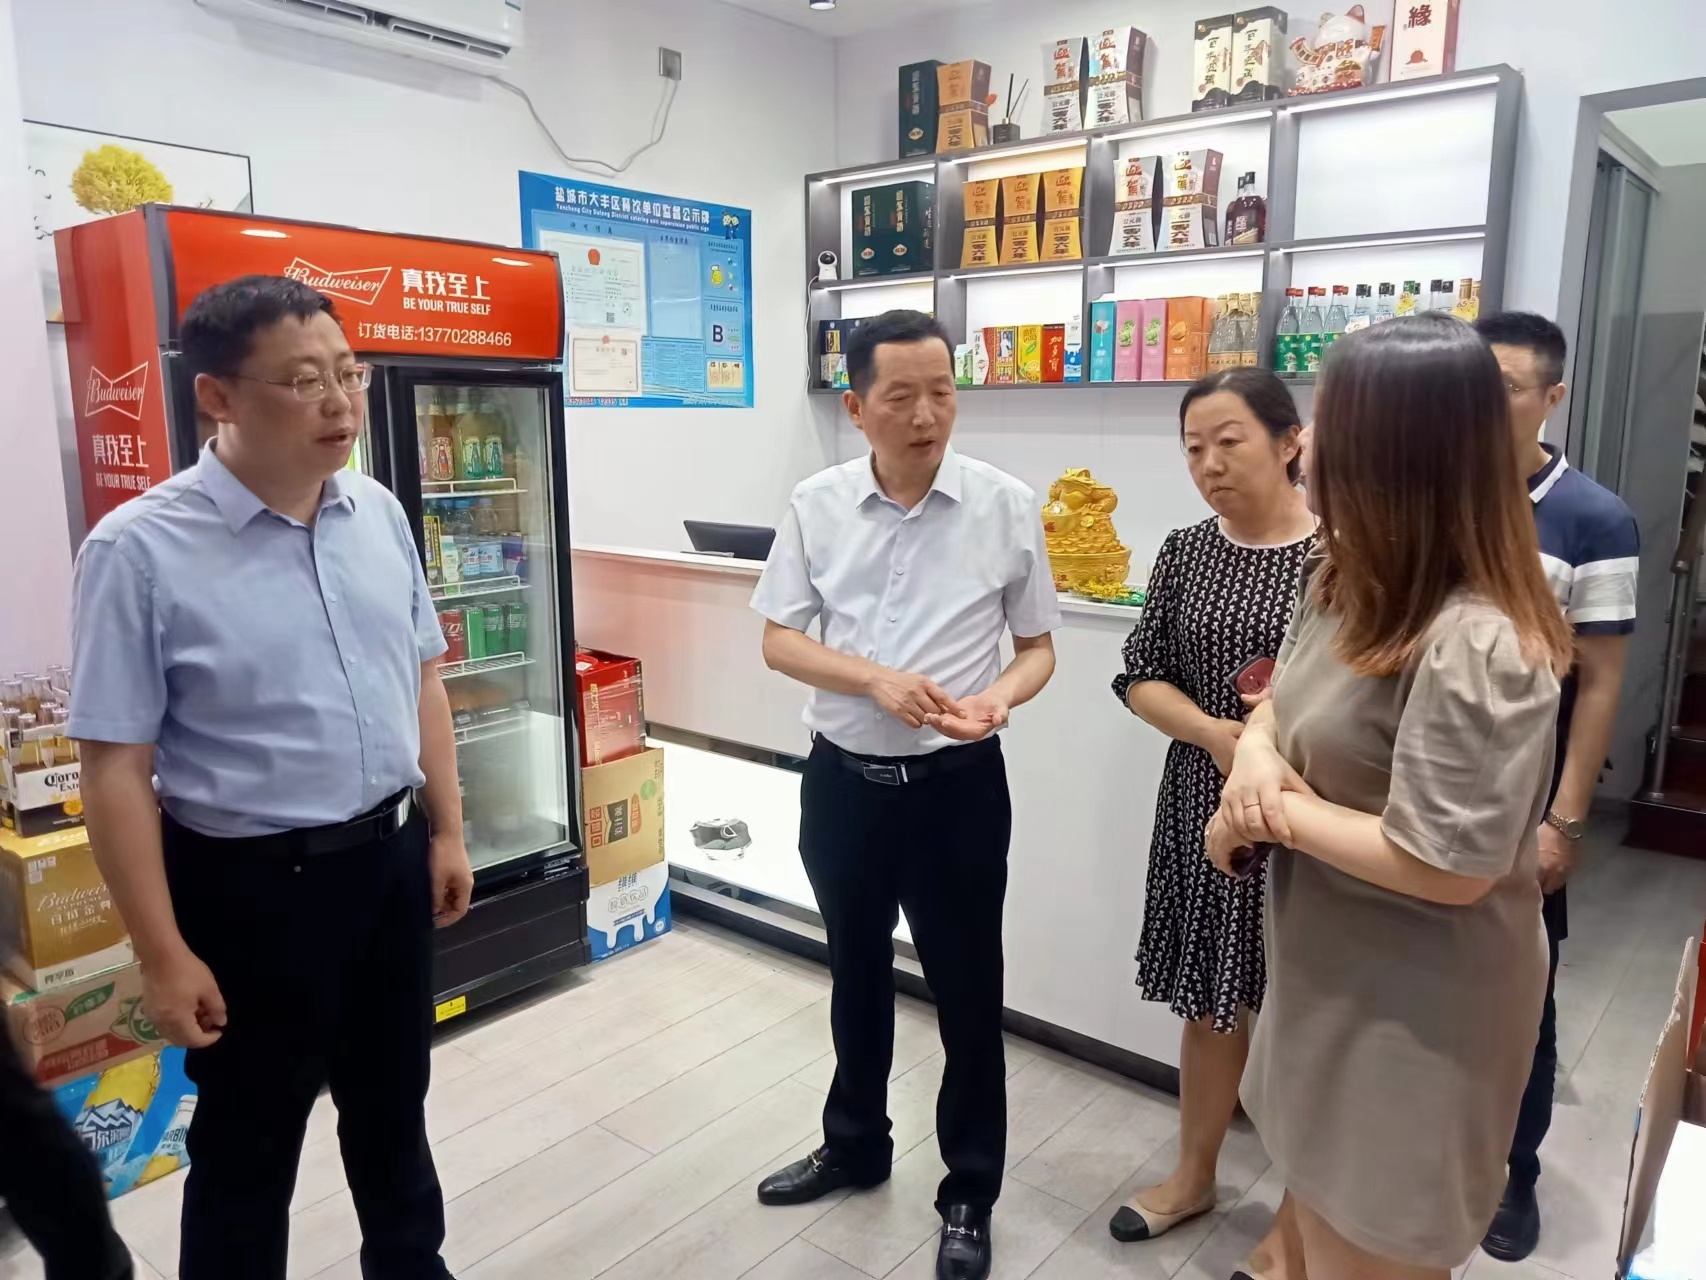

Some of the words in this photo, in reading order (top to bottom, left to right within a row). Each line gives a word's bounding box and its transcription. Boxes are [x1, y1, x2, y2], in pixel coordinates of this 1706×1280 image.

[284, 265, 381, 291] Budweiser
[401, 268, 491, 300] 真我至上
[403, 297, 417, 310] BE
[418, 299, 444, 312] YOUR
[444, 301, 469, 314] TRUE
[470, 303, 491, 316] SELF
[712, 324, 724, 343] B
[87, 378, 145, 404] Budweiser
[92, 434, 149, 468] 真我至上
[96, 472, 103, 487] BE
[103, 473, 120, 488] YOUR
[120, 474, 136, 490] TRUE
